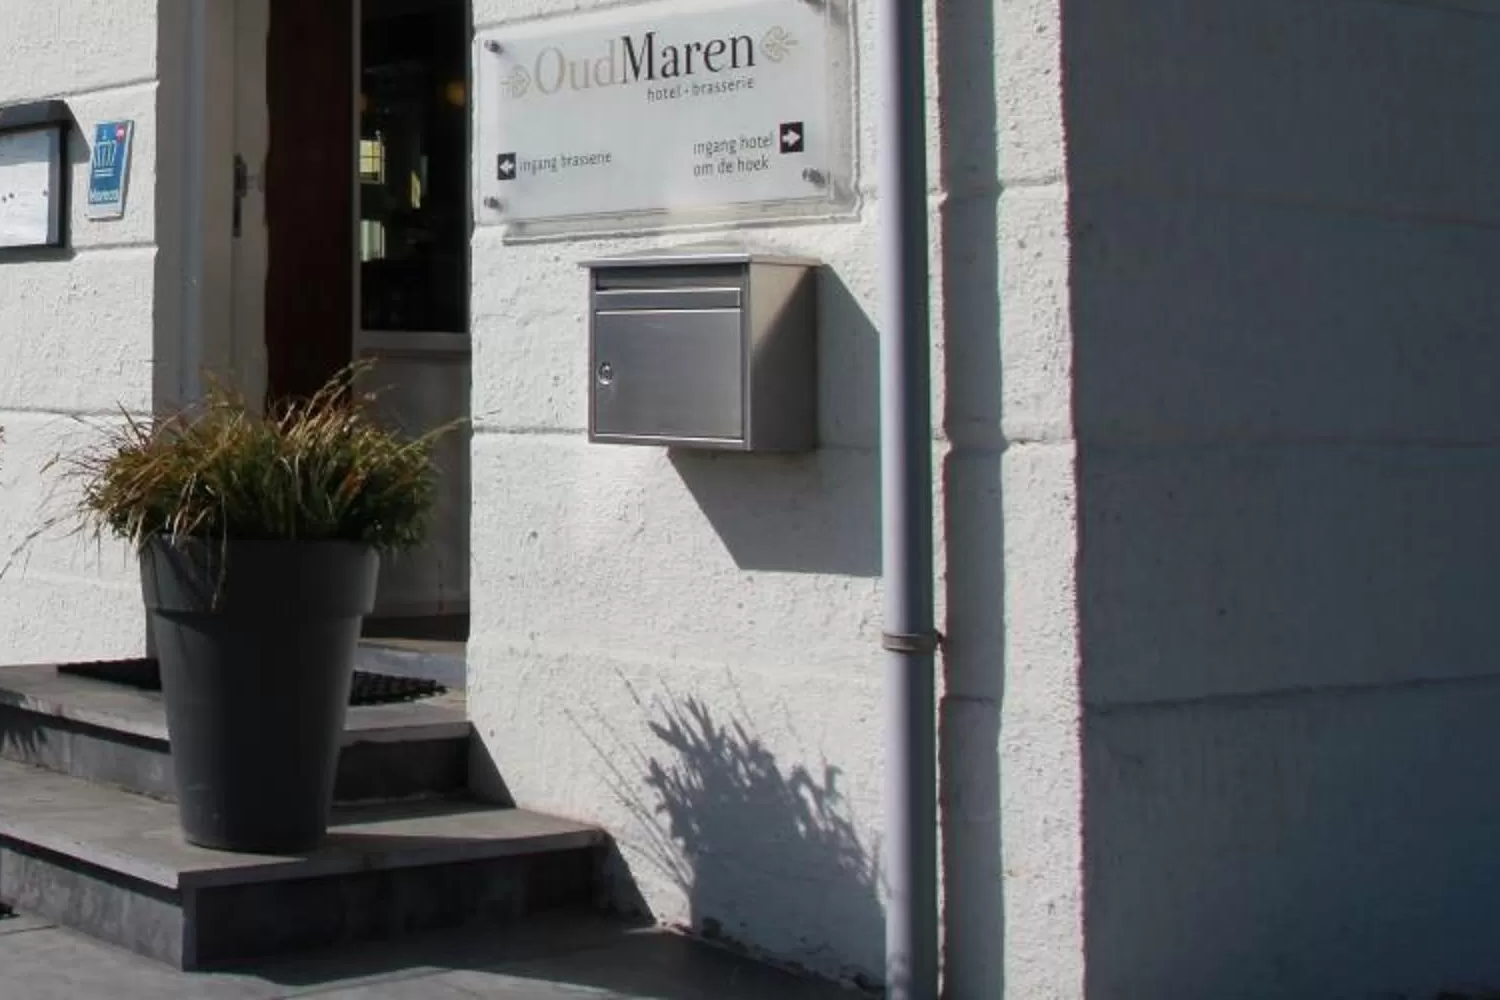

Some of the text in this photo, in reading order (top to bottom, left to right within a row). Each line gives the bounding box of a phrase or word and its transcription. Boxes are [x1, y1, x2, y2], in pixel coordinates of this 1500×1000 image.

[534, 32, 756, 95] OudMaren
[647, 76, 756, 104] hotel brasserie
[739, 131, 773, 150] hotel
[693, 155, 770, 177] om de hoek
